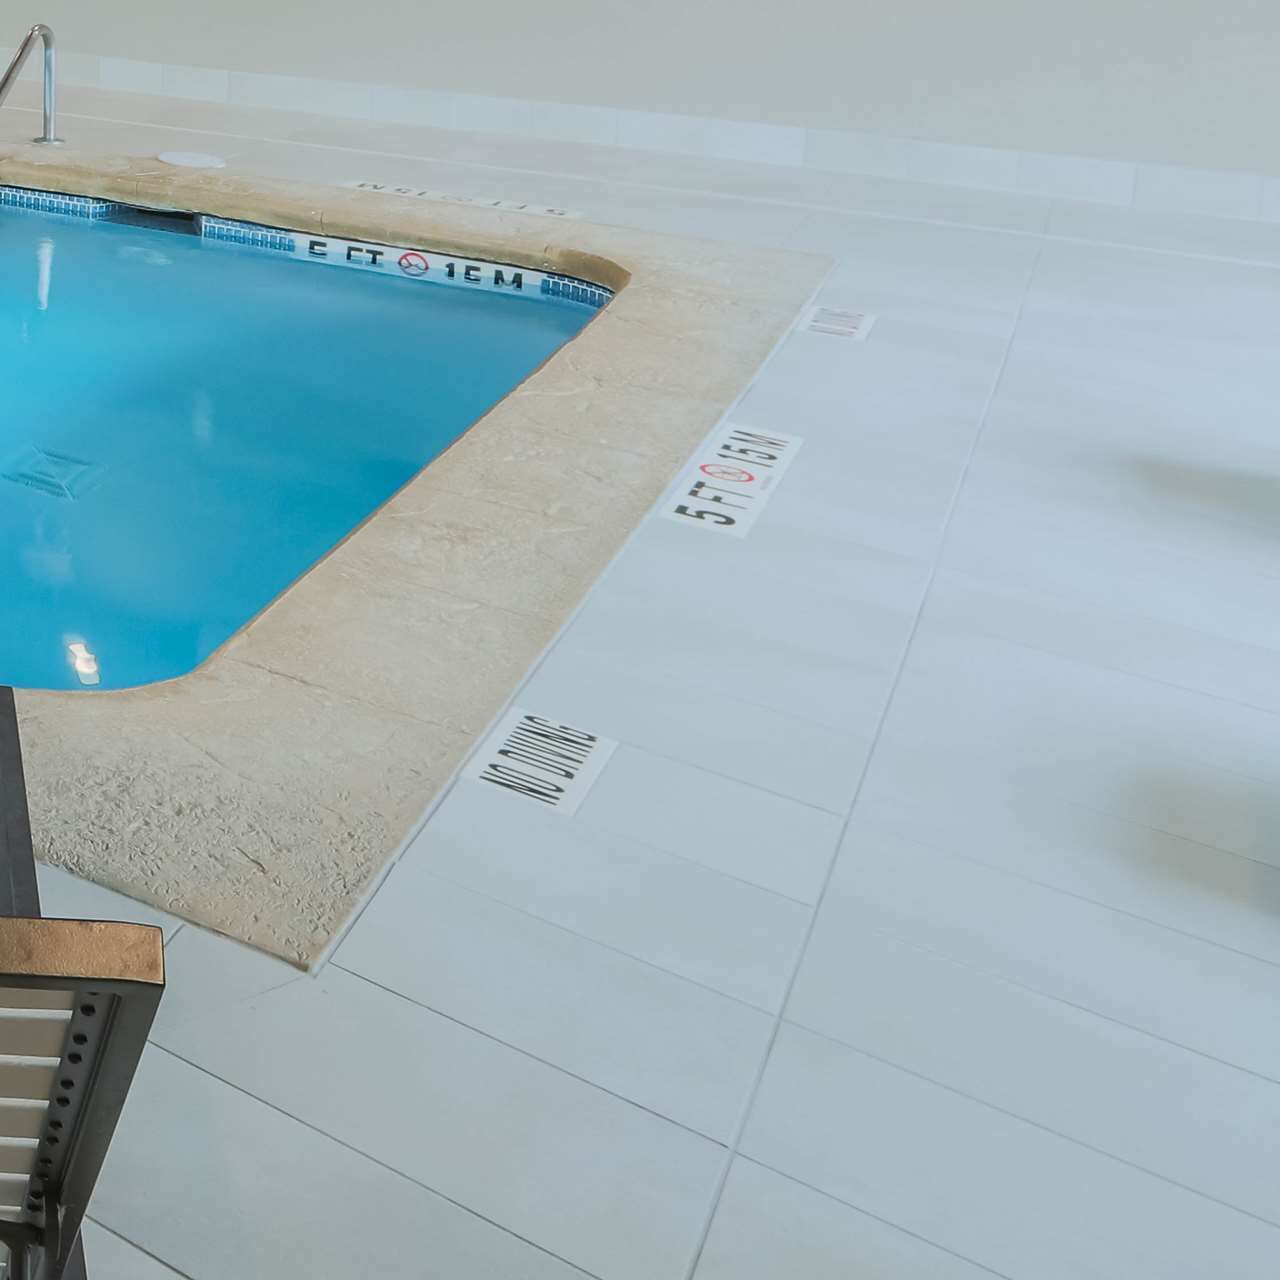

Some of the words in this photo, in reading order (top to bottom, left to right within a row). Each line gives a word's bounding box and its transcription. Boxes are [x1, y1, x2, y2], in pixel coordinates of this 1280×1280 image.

[687, 480, 755, 510] FT
[674, 504, 736, 526] 5
[497, 714, 598, 780] DIVING
[478, 763, 566, 807] NO
